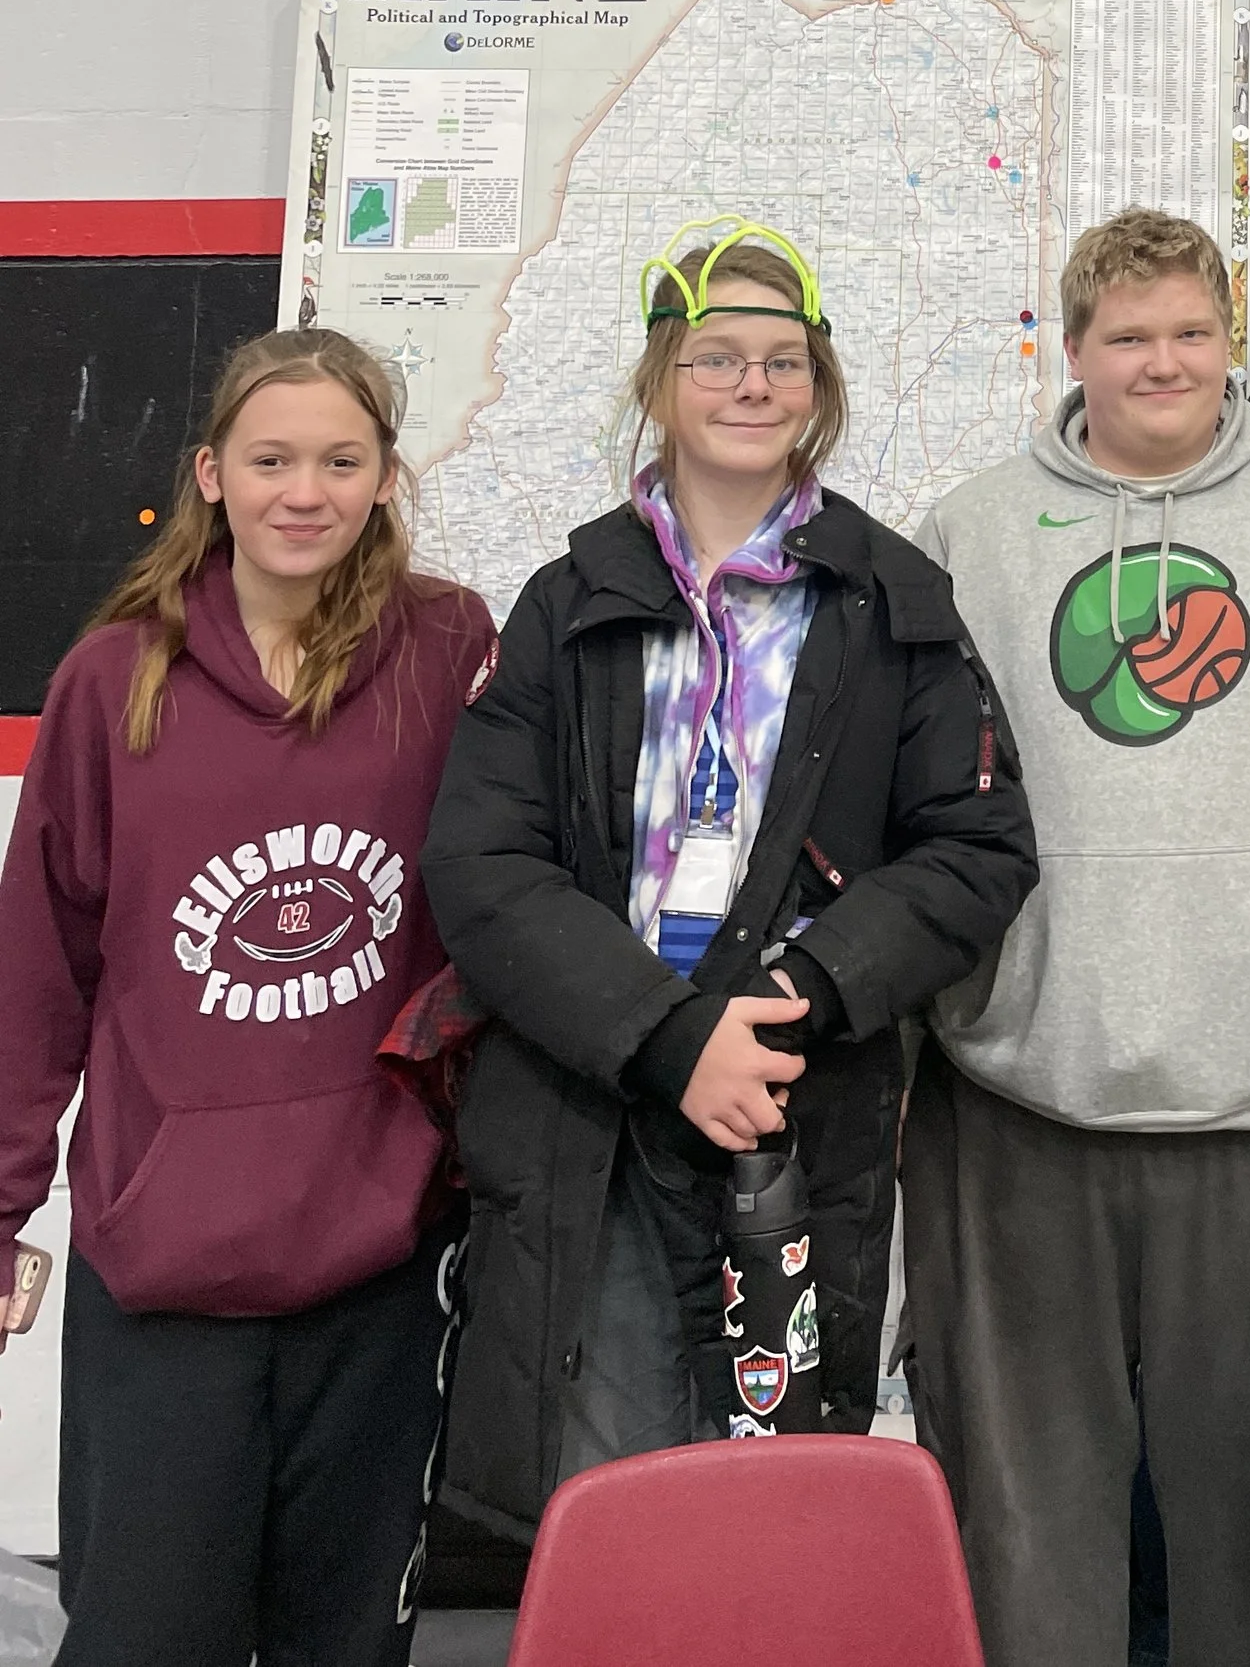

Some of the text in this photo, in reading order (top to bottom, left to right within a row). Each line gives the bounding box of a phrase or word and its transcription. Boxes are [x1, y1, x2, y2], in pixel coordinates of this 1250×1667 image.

[367, 8, 629, 27] Political and Topographical Map
[384, 272, 407, 281] Scale
[172, 823, 405, 937] Ellsworth
[277, 901, 311, 934] 42
[199, 940, 387, 1023] Football
[743, 1359, 778, 1371] MAINE
